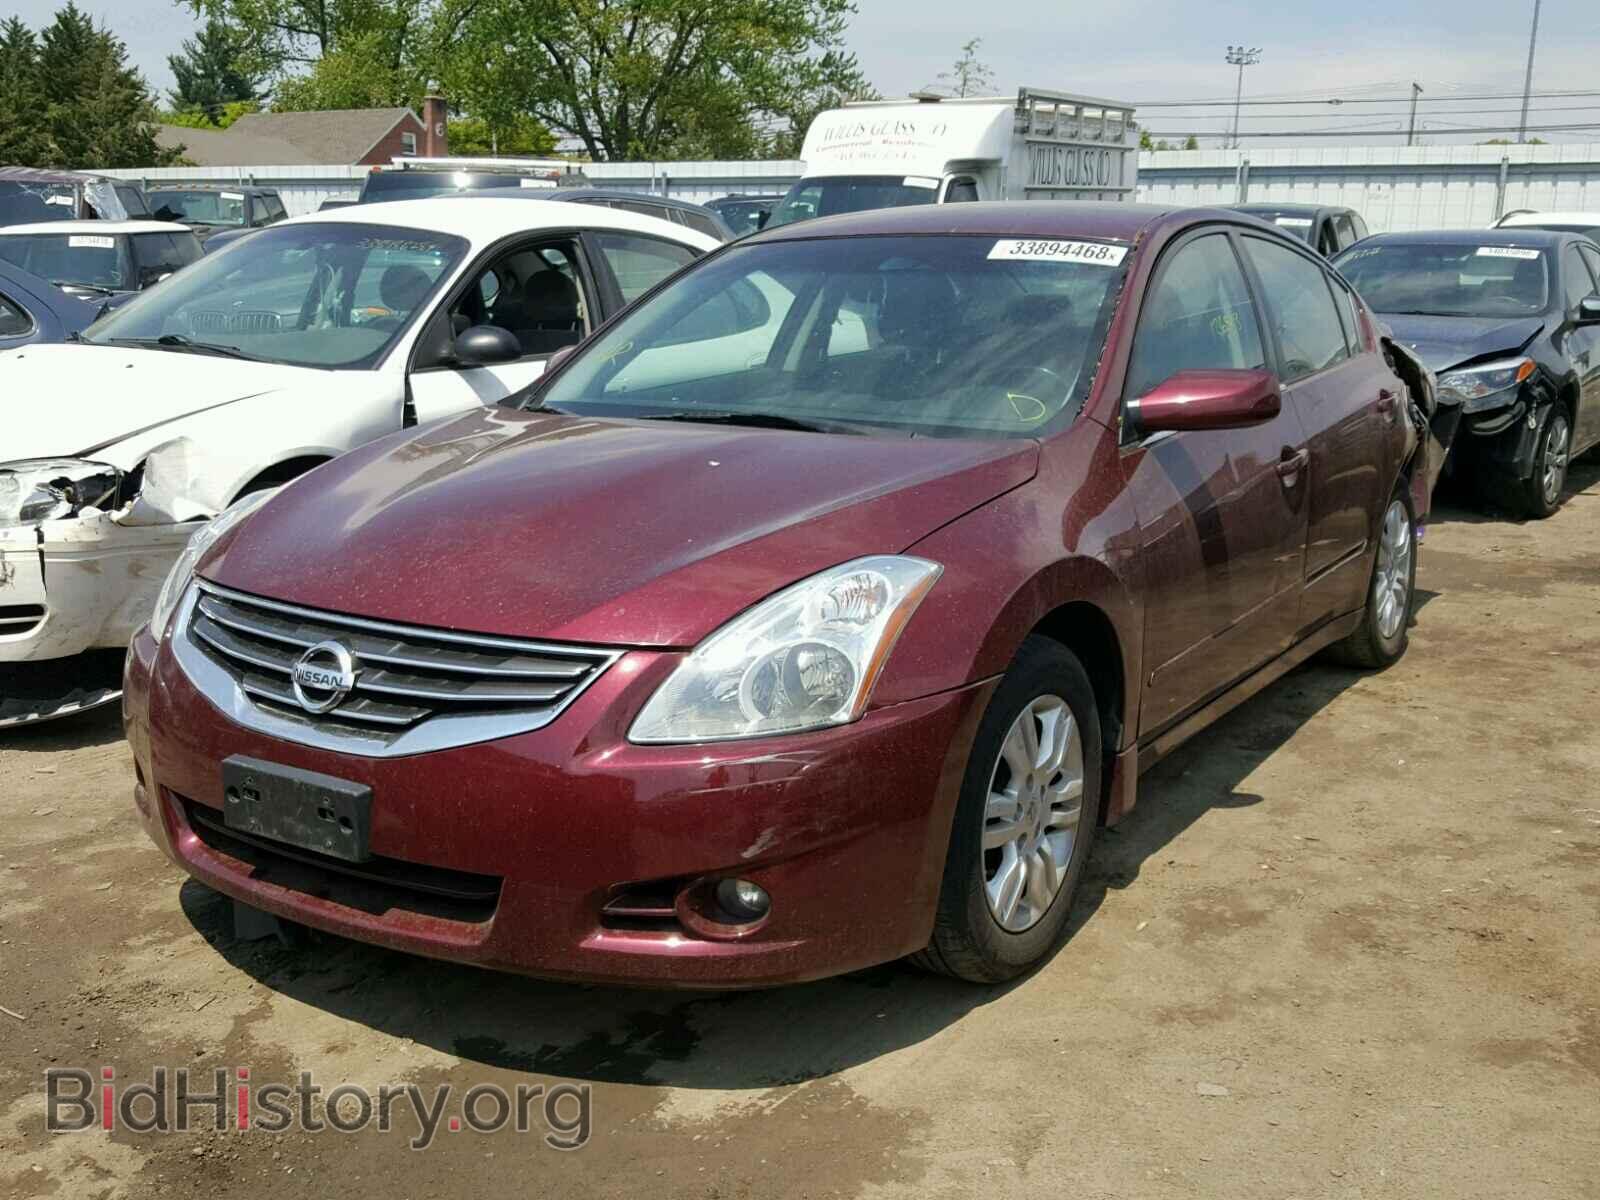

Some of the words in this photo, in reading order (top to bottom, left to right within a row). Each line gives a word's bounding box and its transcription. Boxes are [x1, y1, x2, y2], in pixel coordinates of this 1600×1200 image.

[869, 119, 916, 137] GLASS
[1029, 145, 1061, 185] WILLIS
[1065, 148, 1094, 186] GLASS
[295, 667, 344, 687] NISSAN
